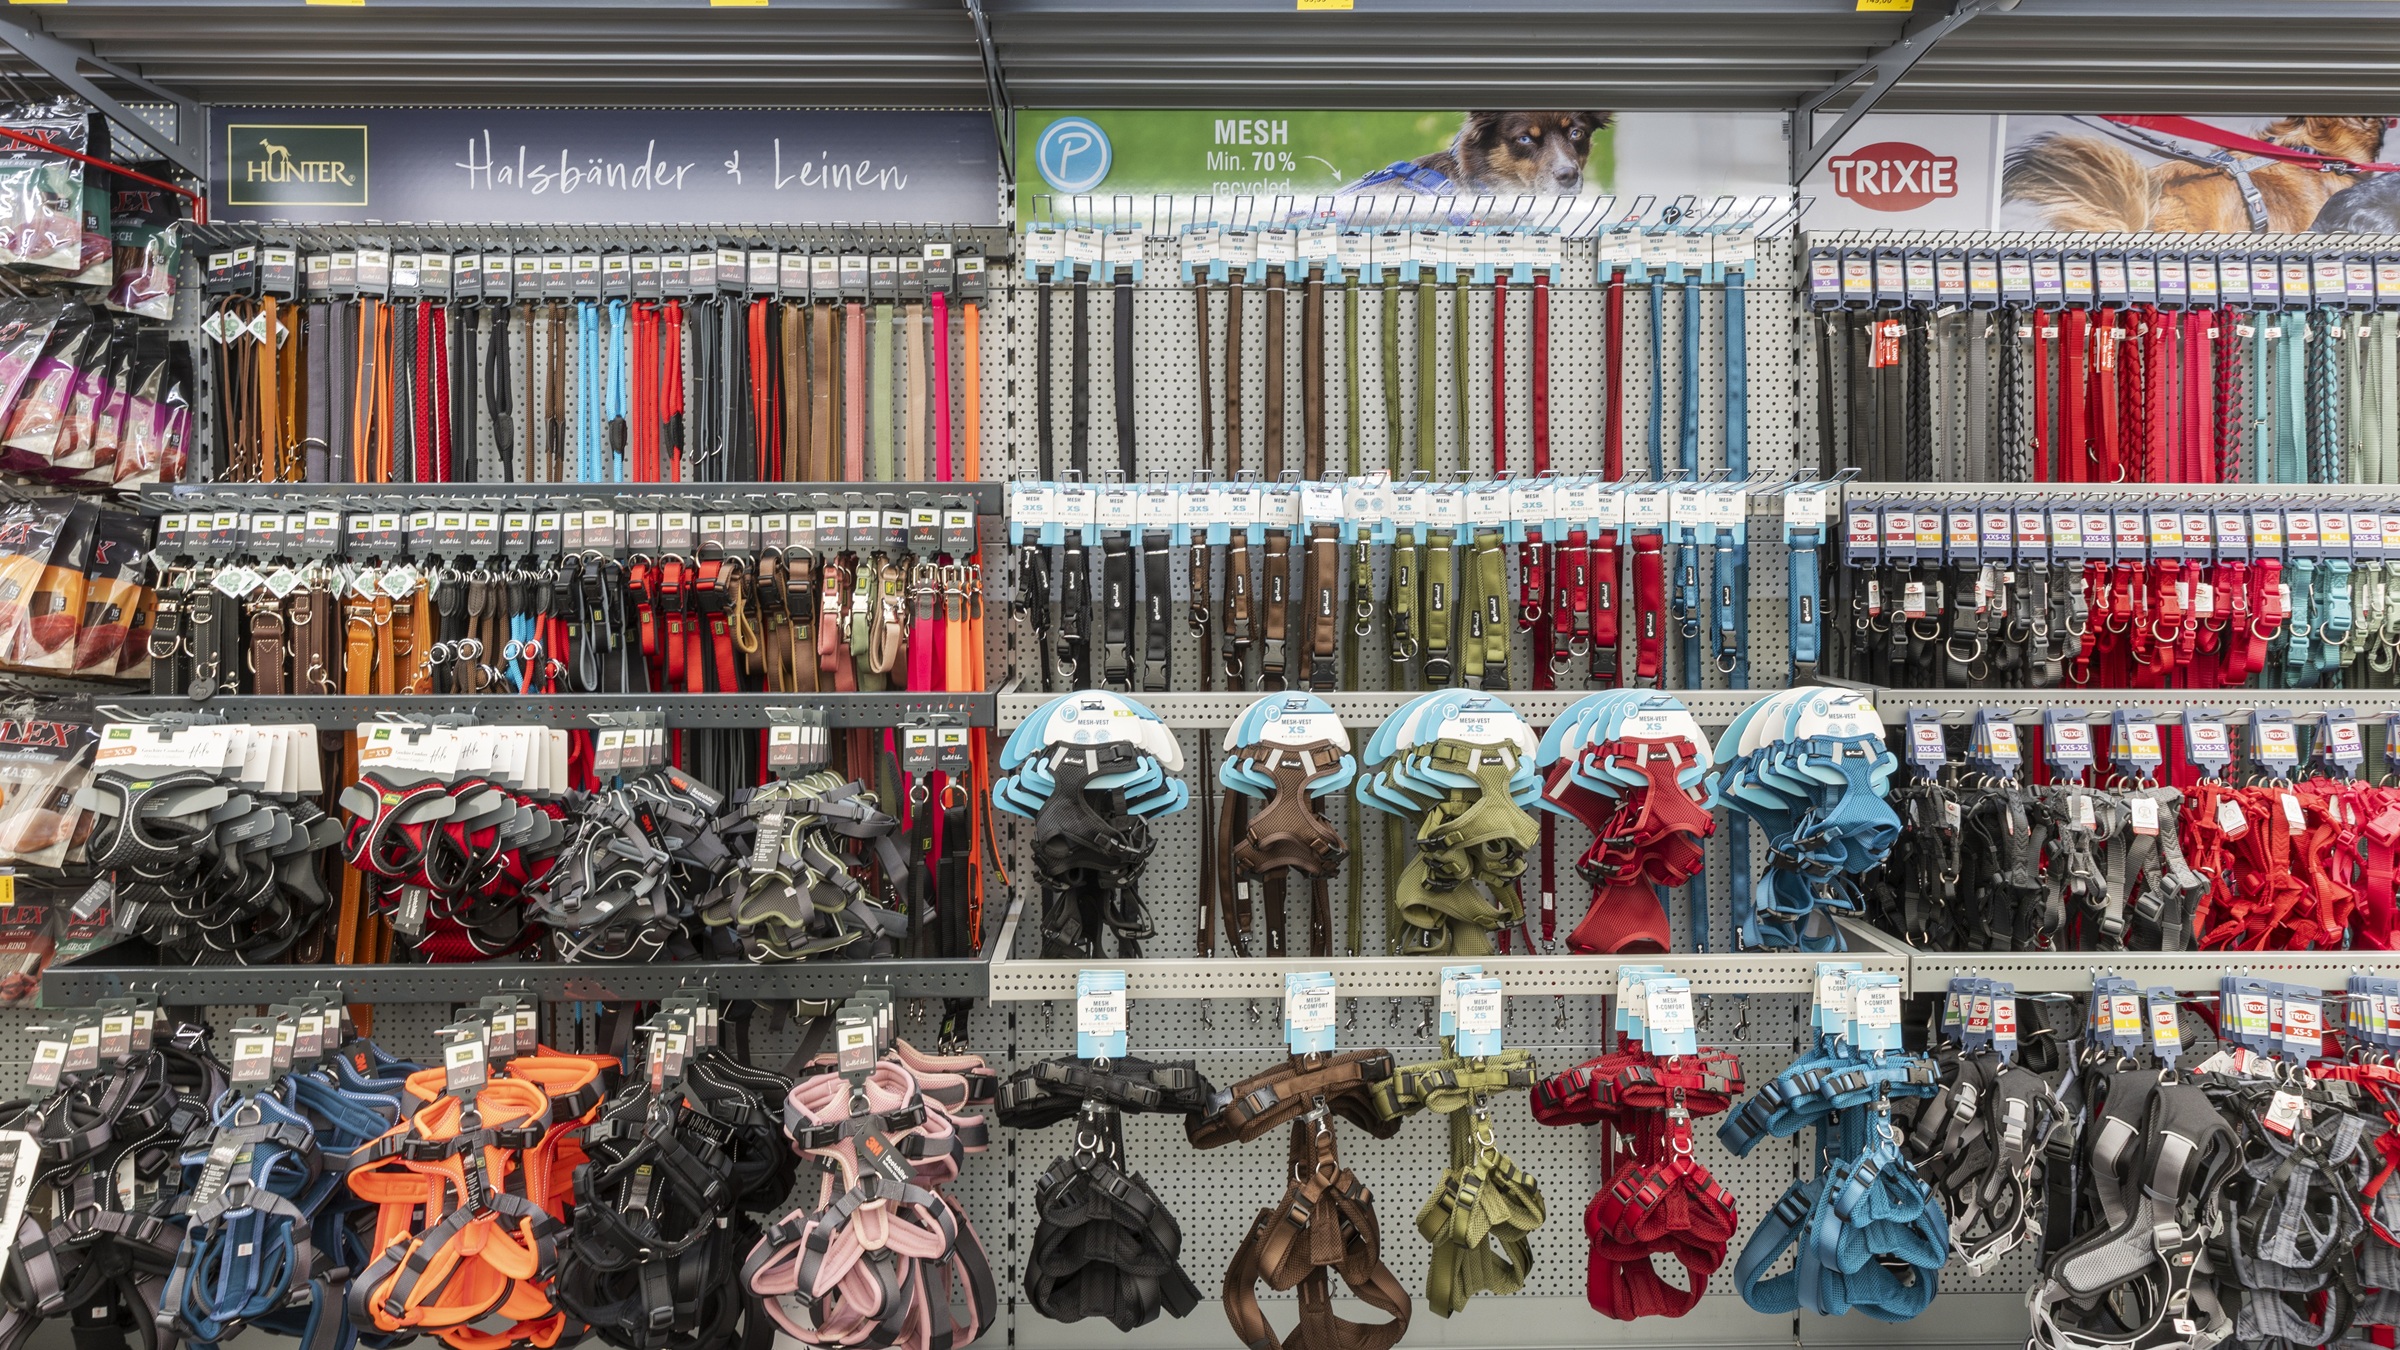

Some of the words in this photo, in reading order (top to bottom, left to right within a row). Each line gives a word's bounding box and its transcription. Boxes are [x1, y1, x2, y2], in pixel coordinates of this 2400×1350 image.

[1215, 120, 1287, 145] MESH
[456, 128, 696, 194] Halsbänder
[724, 150, 742, 185] &
[774, 138, 908, 190] Leinen
[1207, 151, 1245, 171] Min.
[1252, 152, 1296, 171] 70%
[247, 161, 353, 186] HUNTER
[1213, 178, 1290, 197] recycled
[88, 217, 97, 225] 15
[56, 597, 65, 606] 15
[111, 609, 120, 617] 15
[1646, 723, 1662, 731] XS
[114, 747, 133, 756] XXS
[375, 749, 389, 757] XXS
[2335, 743, 2359, 752] XXS-XS
[671, 776, 688, 791] 3M
[641, 814, 653, 833] 3M
[2293, 1028, 2313, 1036] XS-S
[354, 1052, 368, 1073] 3M
[865, 1136, 883, 1157] 3M
[885, 1154, 909, 1180] Scotchlite
